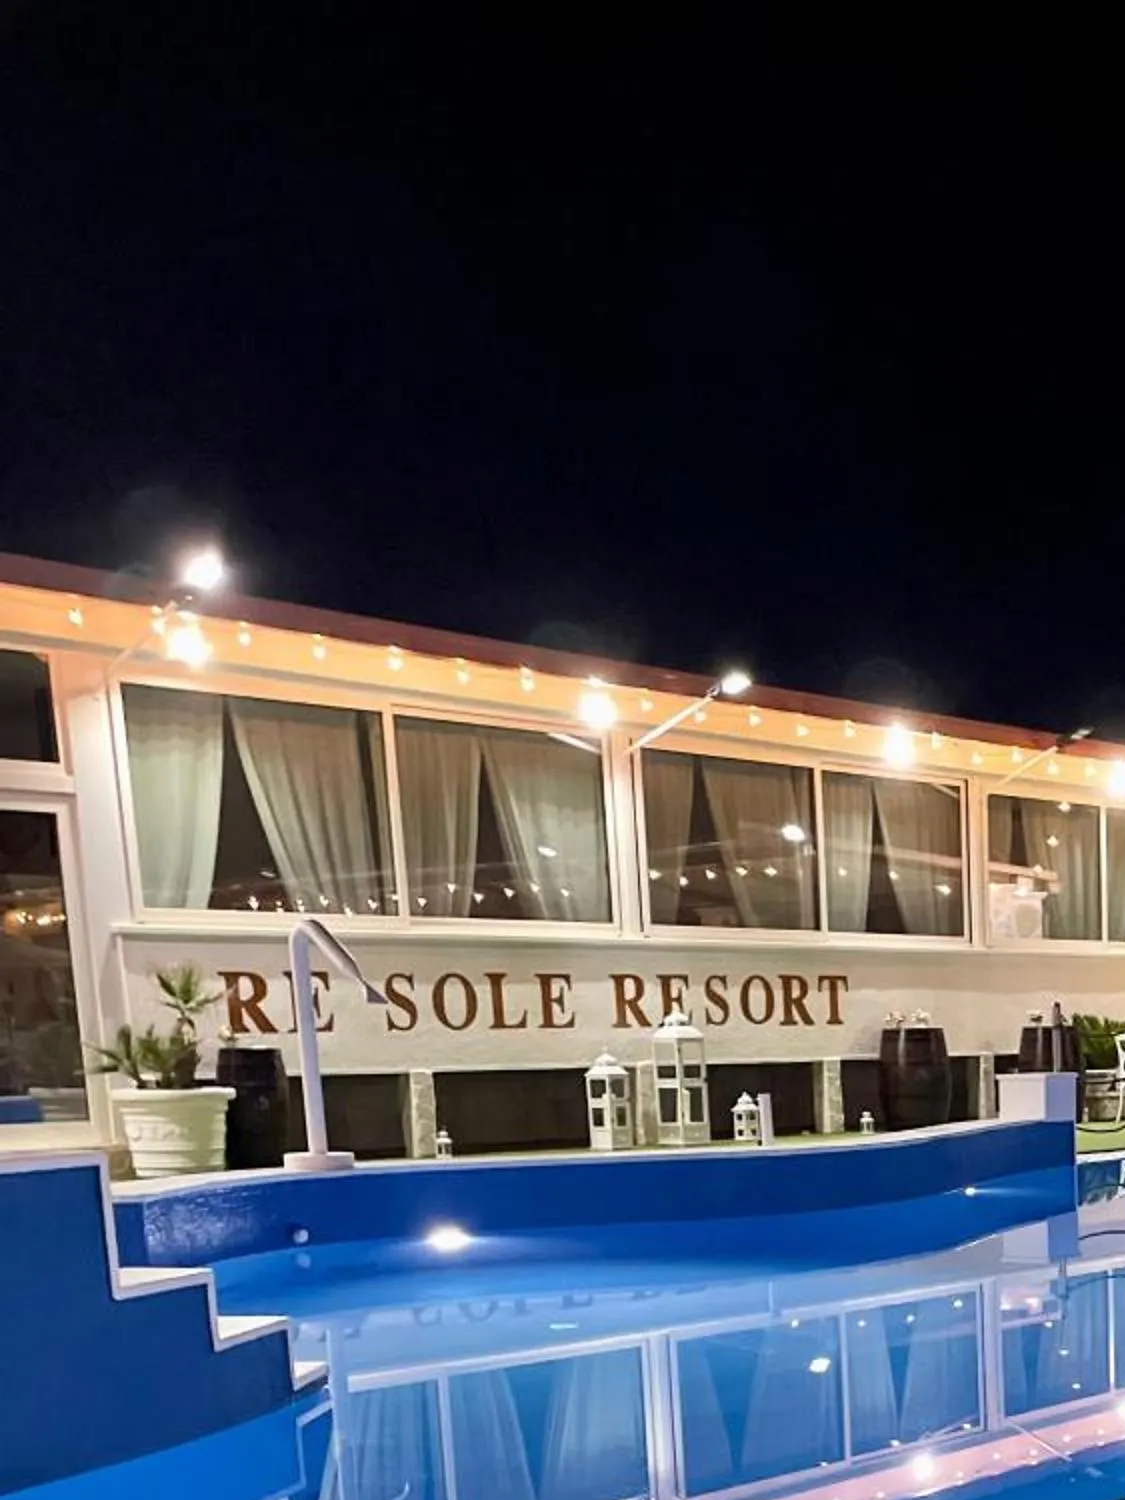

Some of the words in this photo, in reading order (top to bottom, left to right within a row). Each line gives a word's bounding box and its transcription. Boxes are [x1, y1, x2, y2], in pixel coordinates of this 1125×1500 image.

[217, 971, 334, 1033] RE
[385, 972, 576, 1032] SOLE
[608, 973, 850, 1028] RESORT
